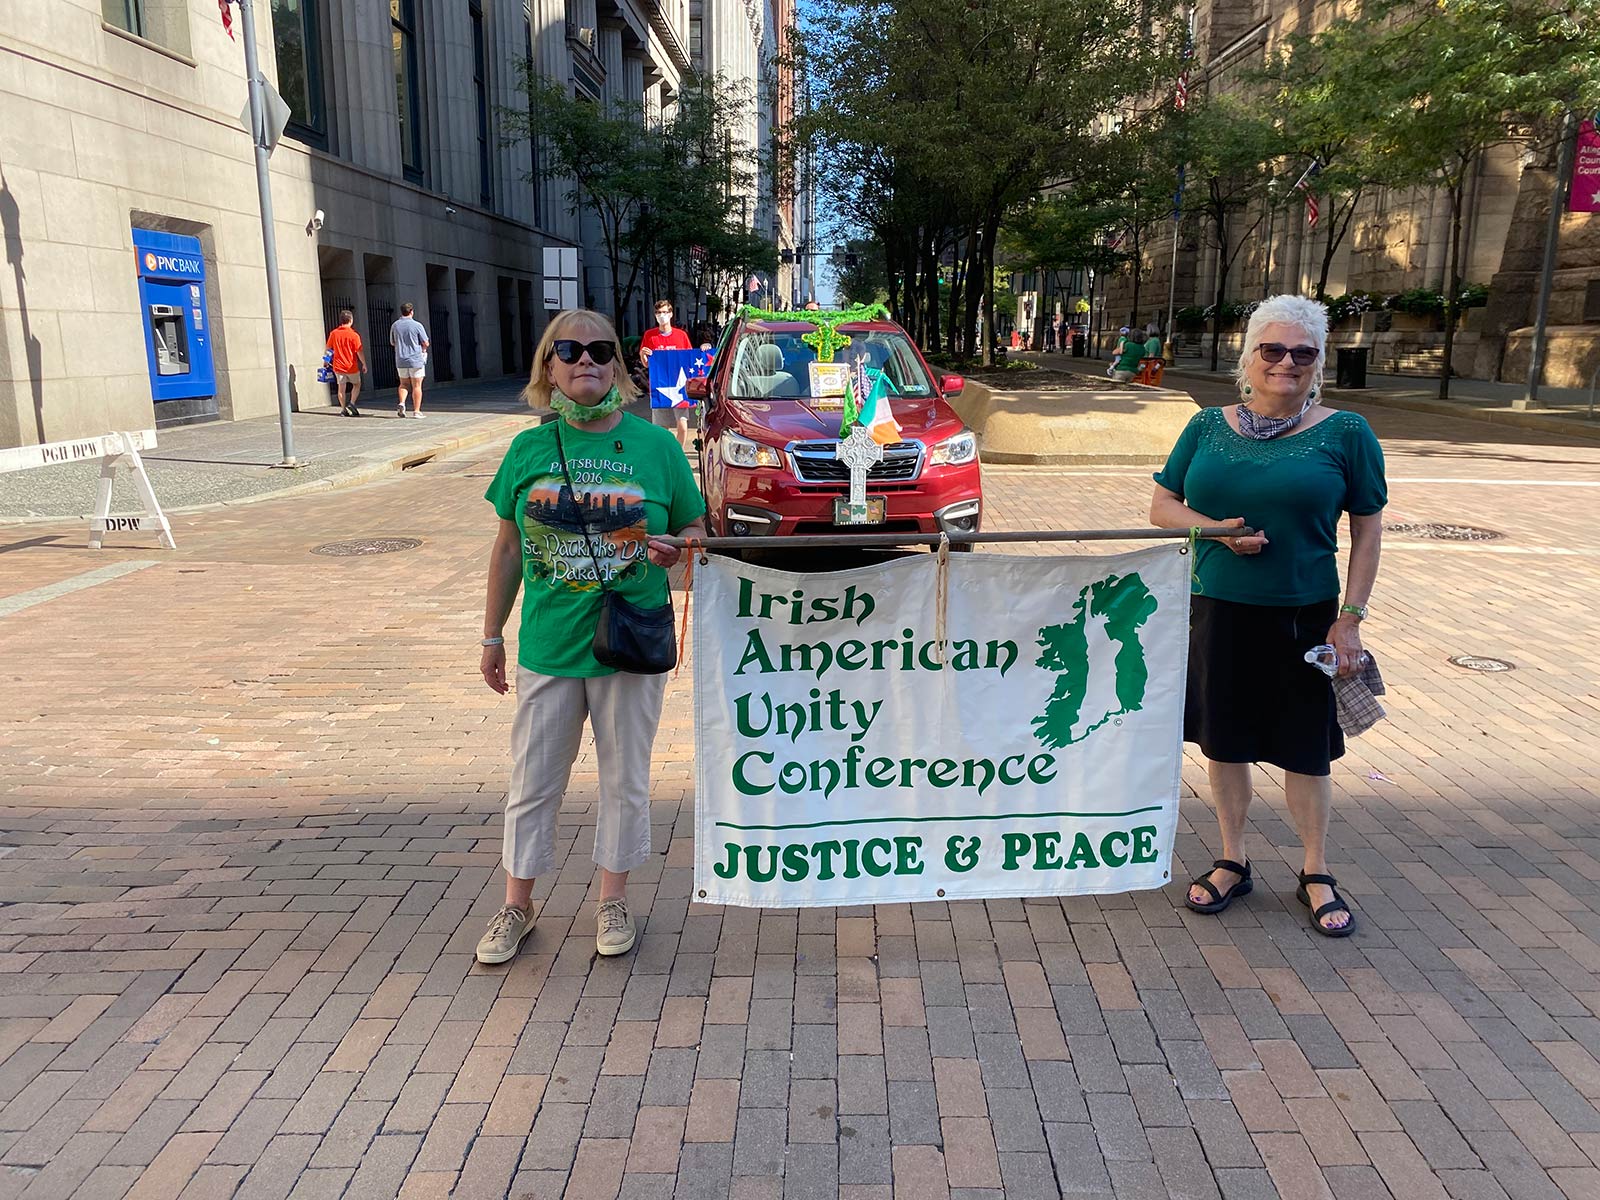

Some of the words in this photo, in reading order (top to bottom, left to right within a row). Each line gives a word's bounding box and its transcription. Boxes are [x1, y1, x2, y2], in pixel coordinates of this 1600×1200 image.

[42, 446, 69, 463] PGH
[72, 442, 97, 459] DPW
[574, 471, 603, 484] 2016
[105, 518, 140, 531] DPW
[736, 576, 876, 627] Irish
[733, 627, 1019, 681] American
[733, 687, 884, 744] Unity
[731, 745, 1058, 800] Conference
[712, 835, 926, 883] JUSTICE
[943, 834, 982, 873] &
[1001, 825, 1160, 872] PEACE
